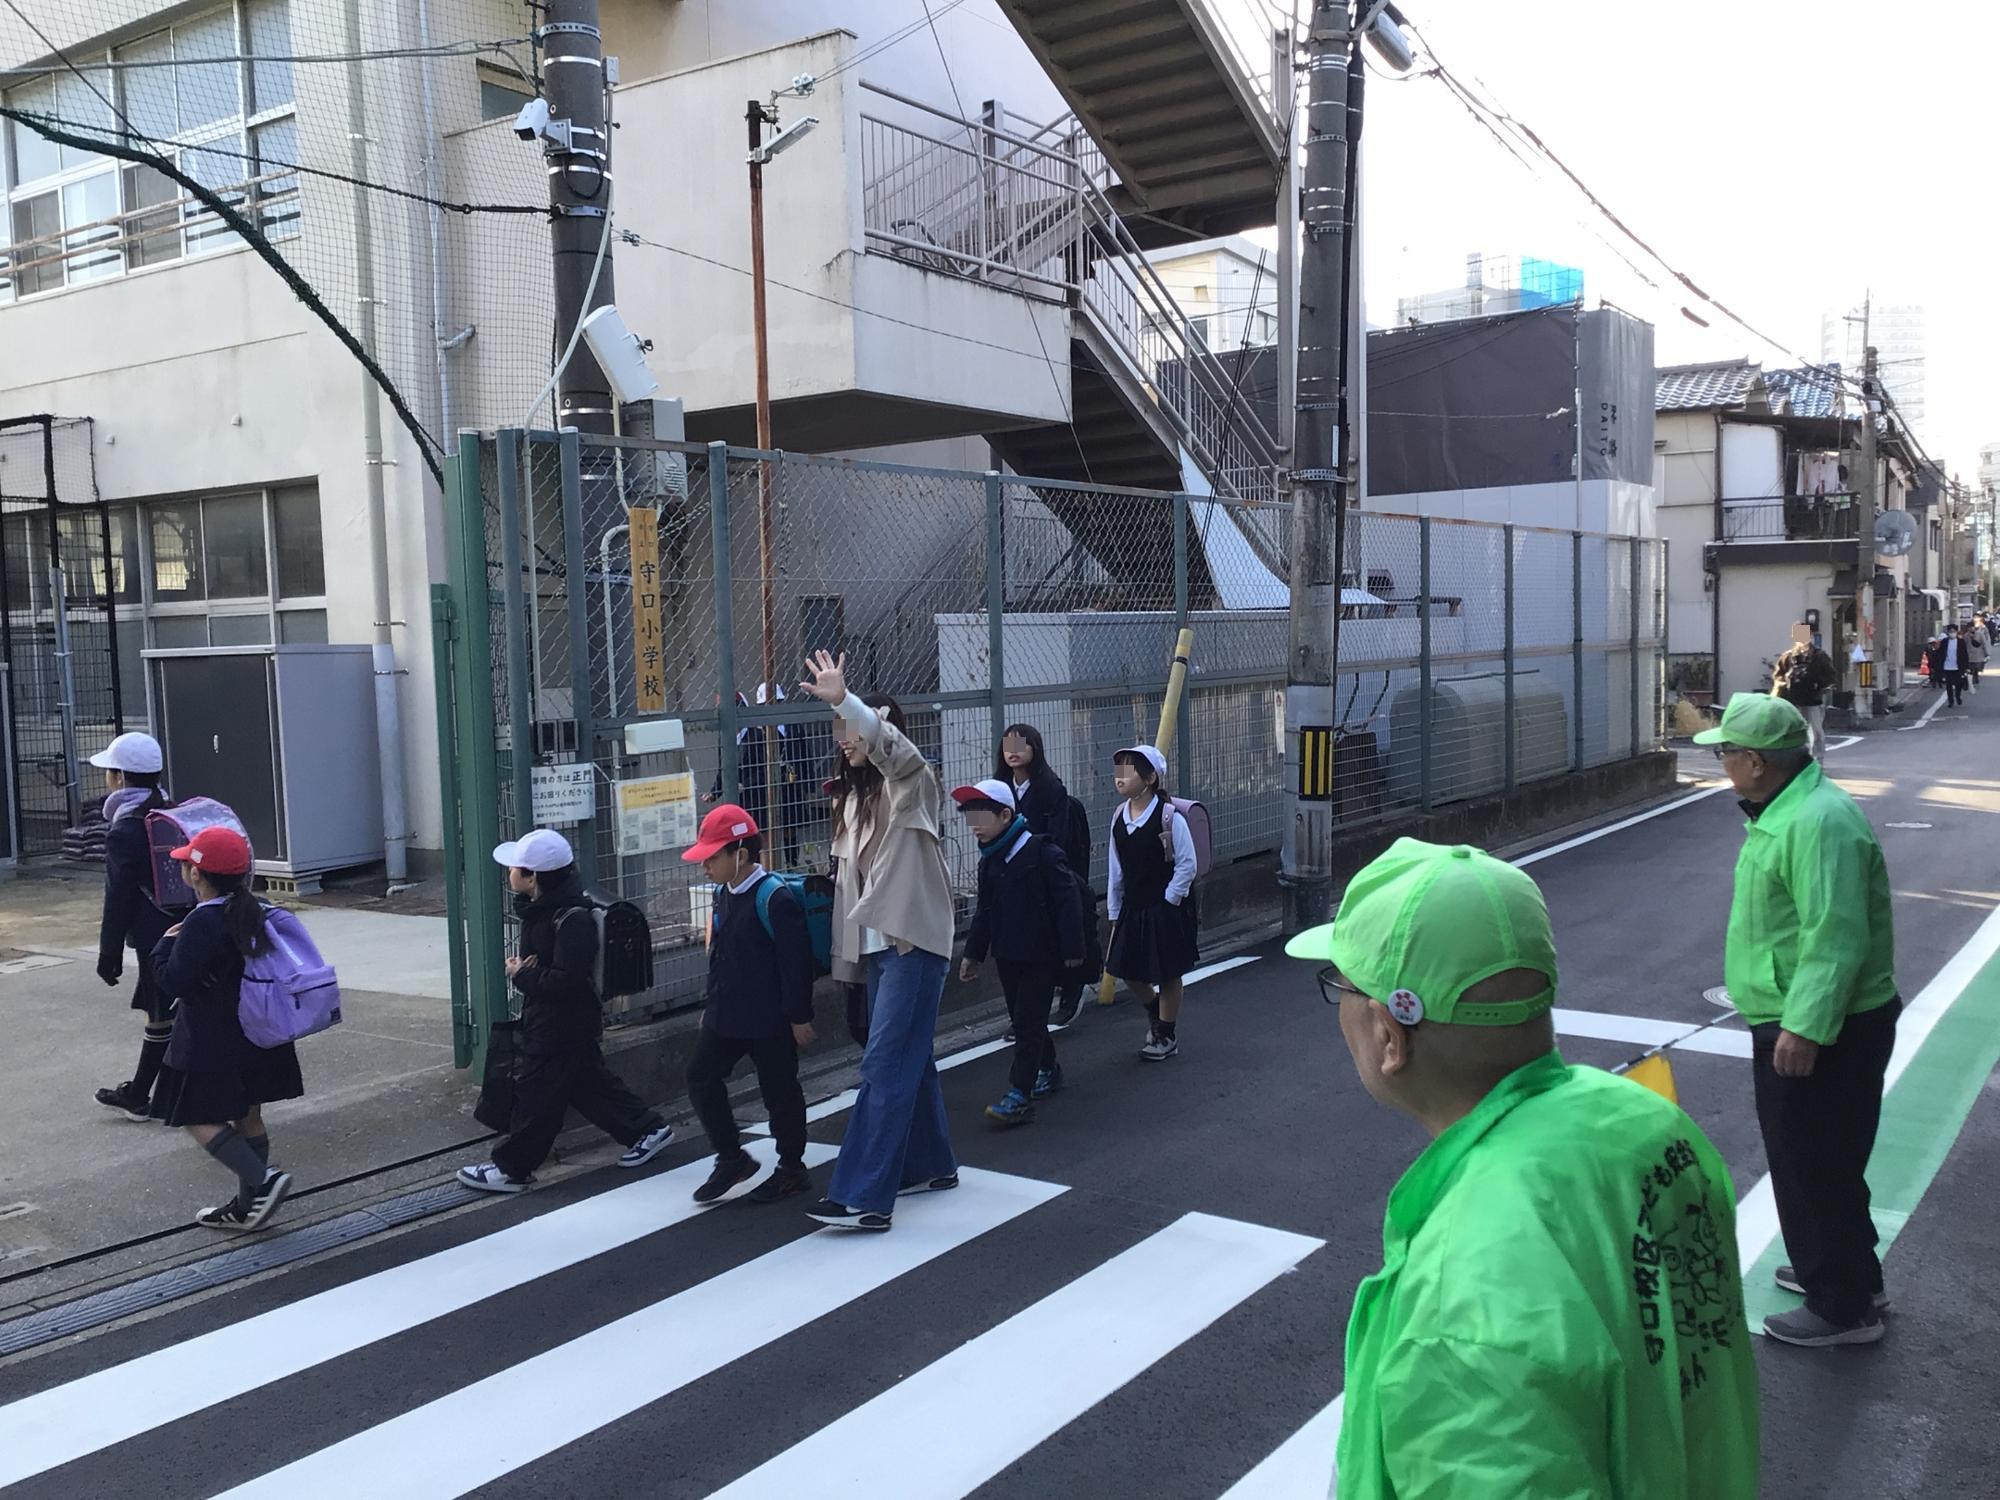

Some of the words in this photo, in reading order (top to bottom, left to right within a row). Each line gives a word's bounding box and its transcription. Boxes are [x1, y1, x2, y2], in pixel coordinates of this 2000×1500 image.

[639, 560, 661, 697] 守口小学校
